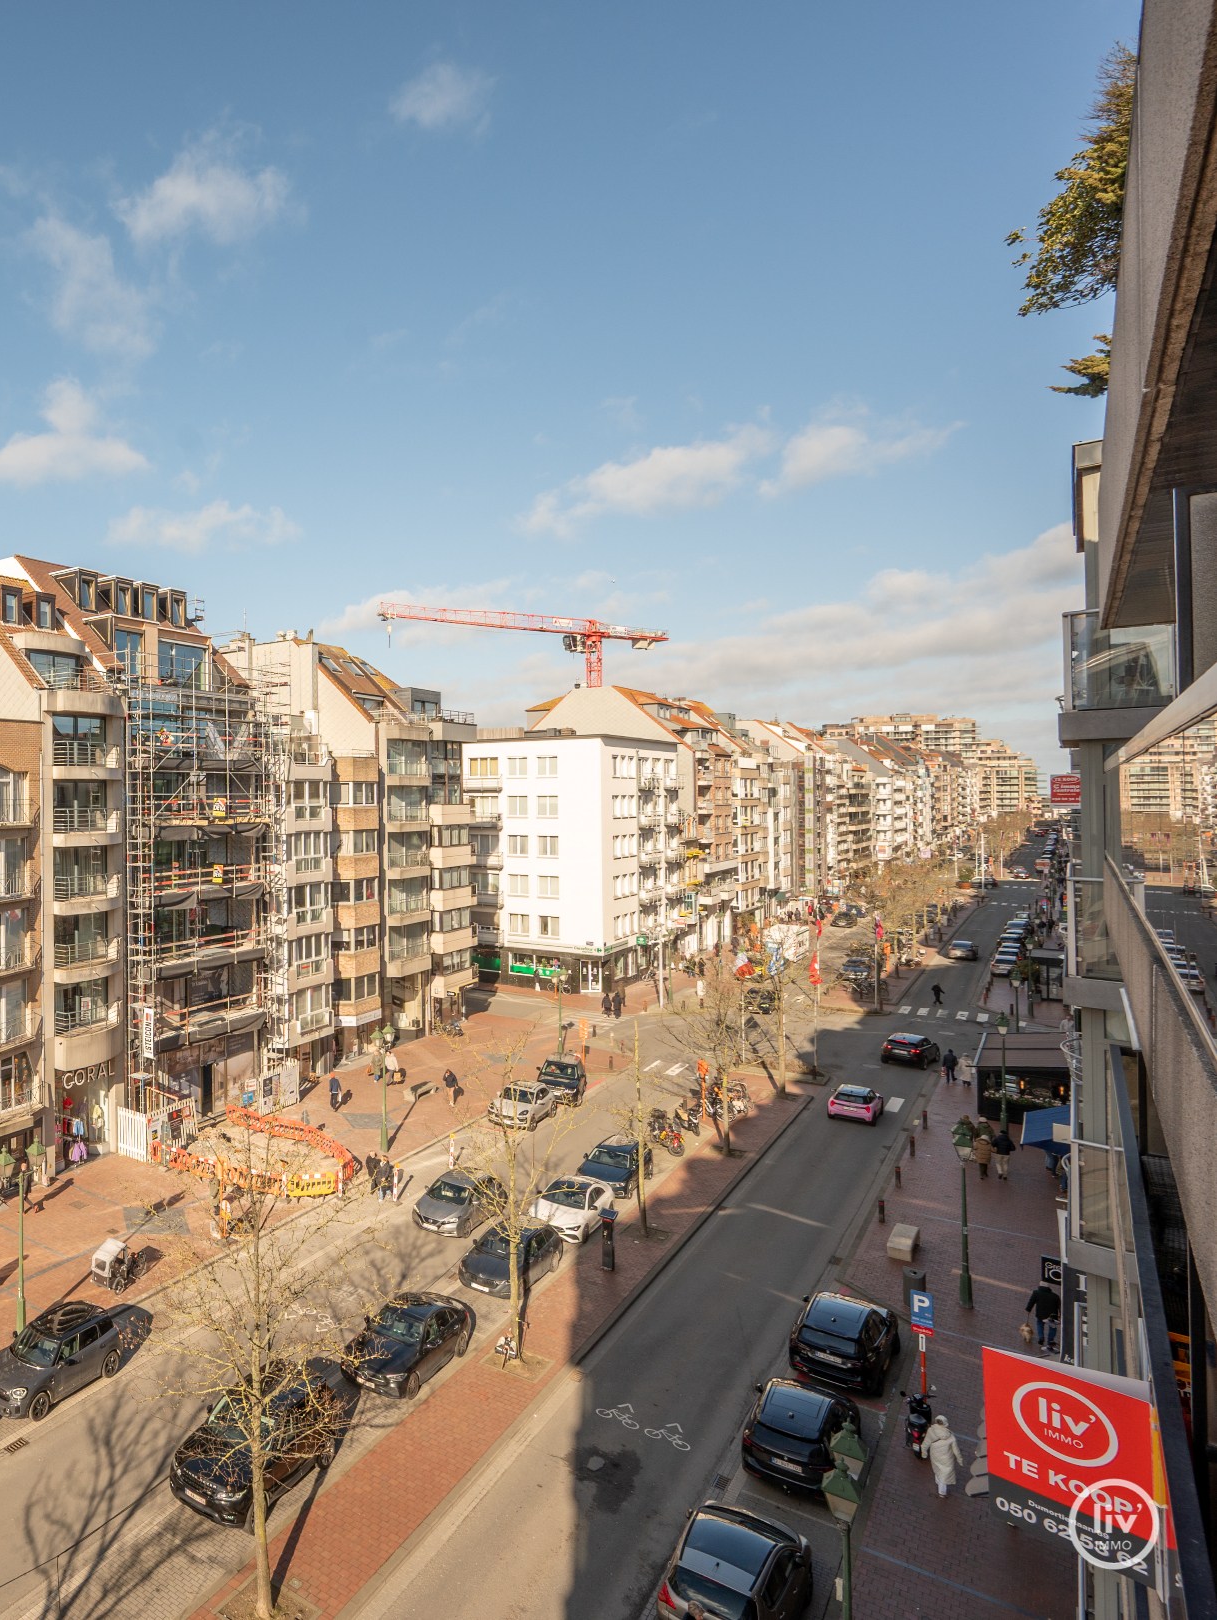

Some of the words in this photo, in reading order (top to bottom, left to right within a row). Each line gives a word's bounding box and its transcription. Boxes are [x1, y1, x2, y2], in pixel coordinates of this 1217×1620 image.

[144, 1021, 152, 1050] STEICON
[913, 1294, 930, 1313] P
[1044, 1428, 1083, 1449] IMMO
[1003, 1451, 1039, 1479] TE
[1048, 1469, 1133, 1513] KOOP
[995, 1496, 1037, 1524] 050
[1043, 1518, 1074, 1541] 62
